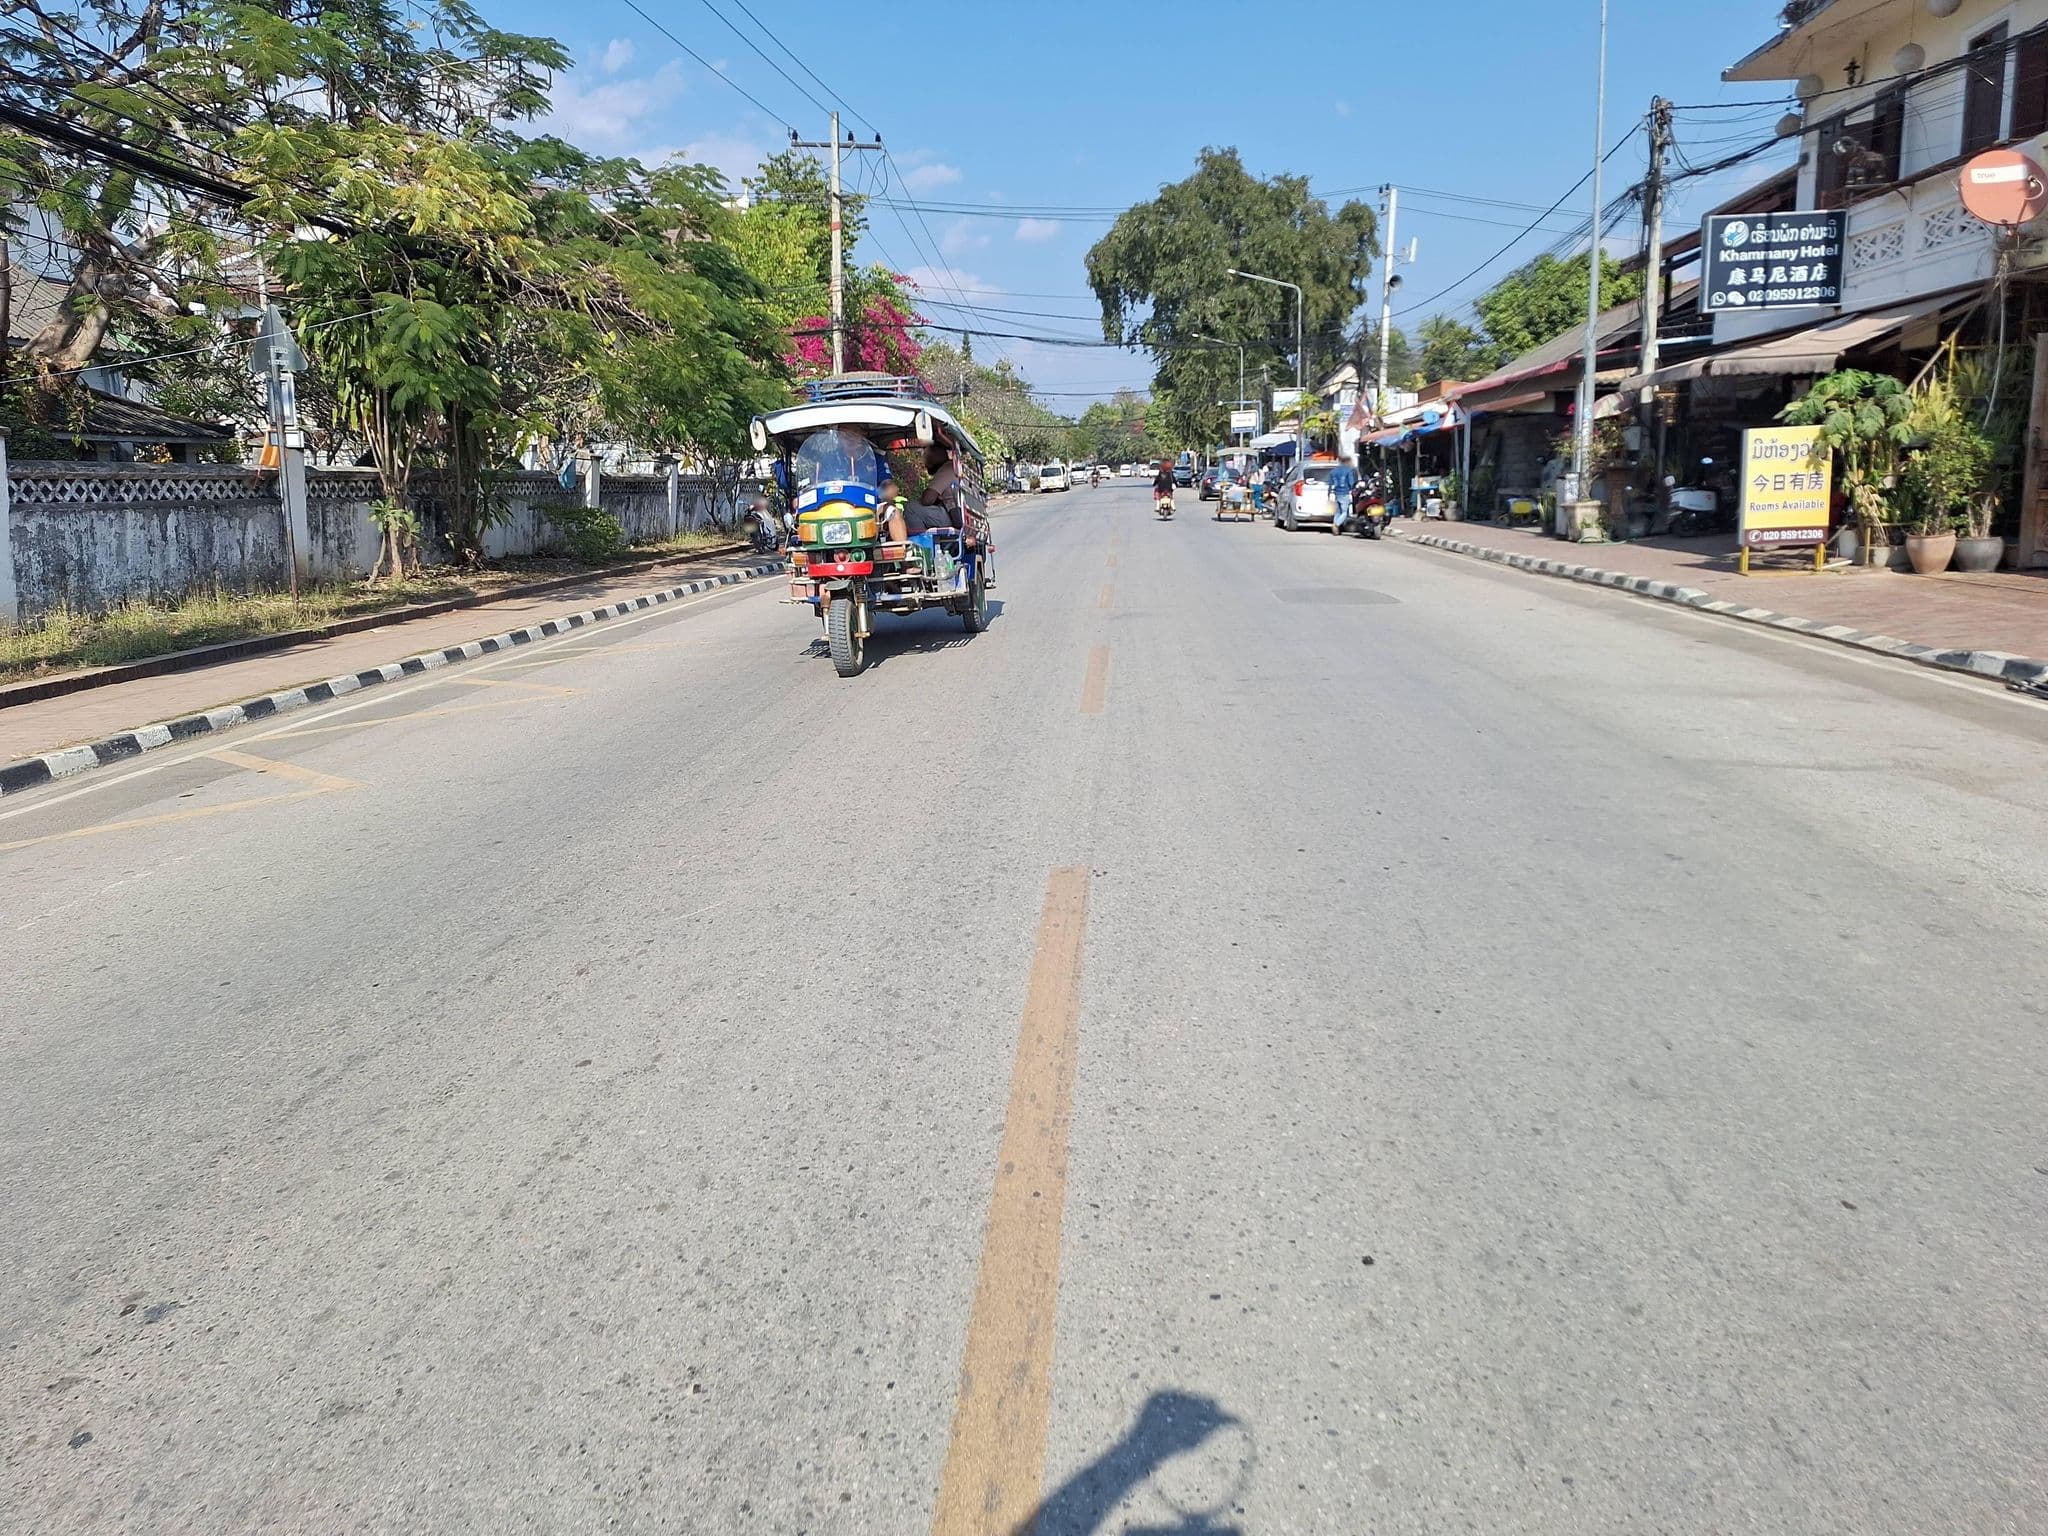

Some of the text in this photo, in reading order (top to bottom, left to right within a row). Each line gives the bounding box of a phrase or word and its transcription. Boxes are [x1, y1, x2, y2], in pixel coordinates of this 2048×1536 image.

[1720, 244, 1838, 262] Khammany Hotel
[1727, 263, 1828, 285] 康马尼酒店
[1748, 286, 1836, 302] 02095912306
[1752, 438, 1829, 461] ມີຫ້ອງວ່
[1753, 471, 1824, 492] 今日有房
[1750, 499, 1825, 511] Rooms Available
[1763, 529, 1824, 540] 020 95912306
